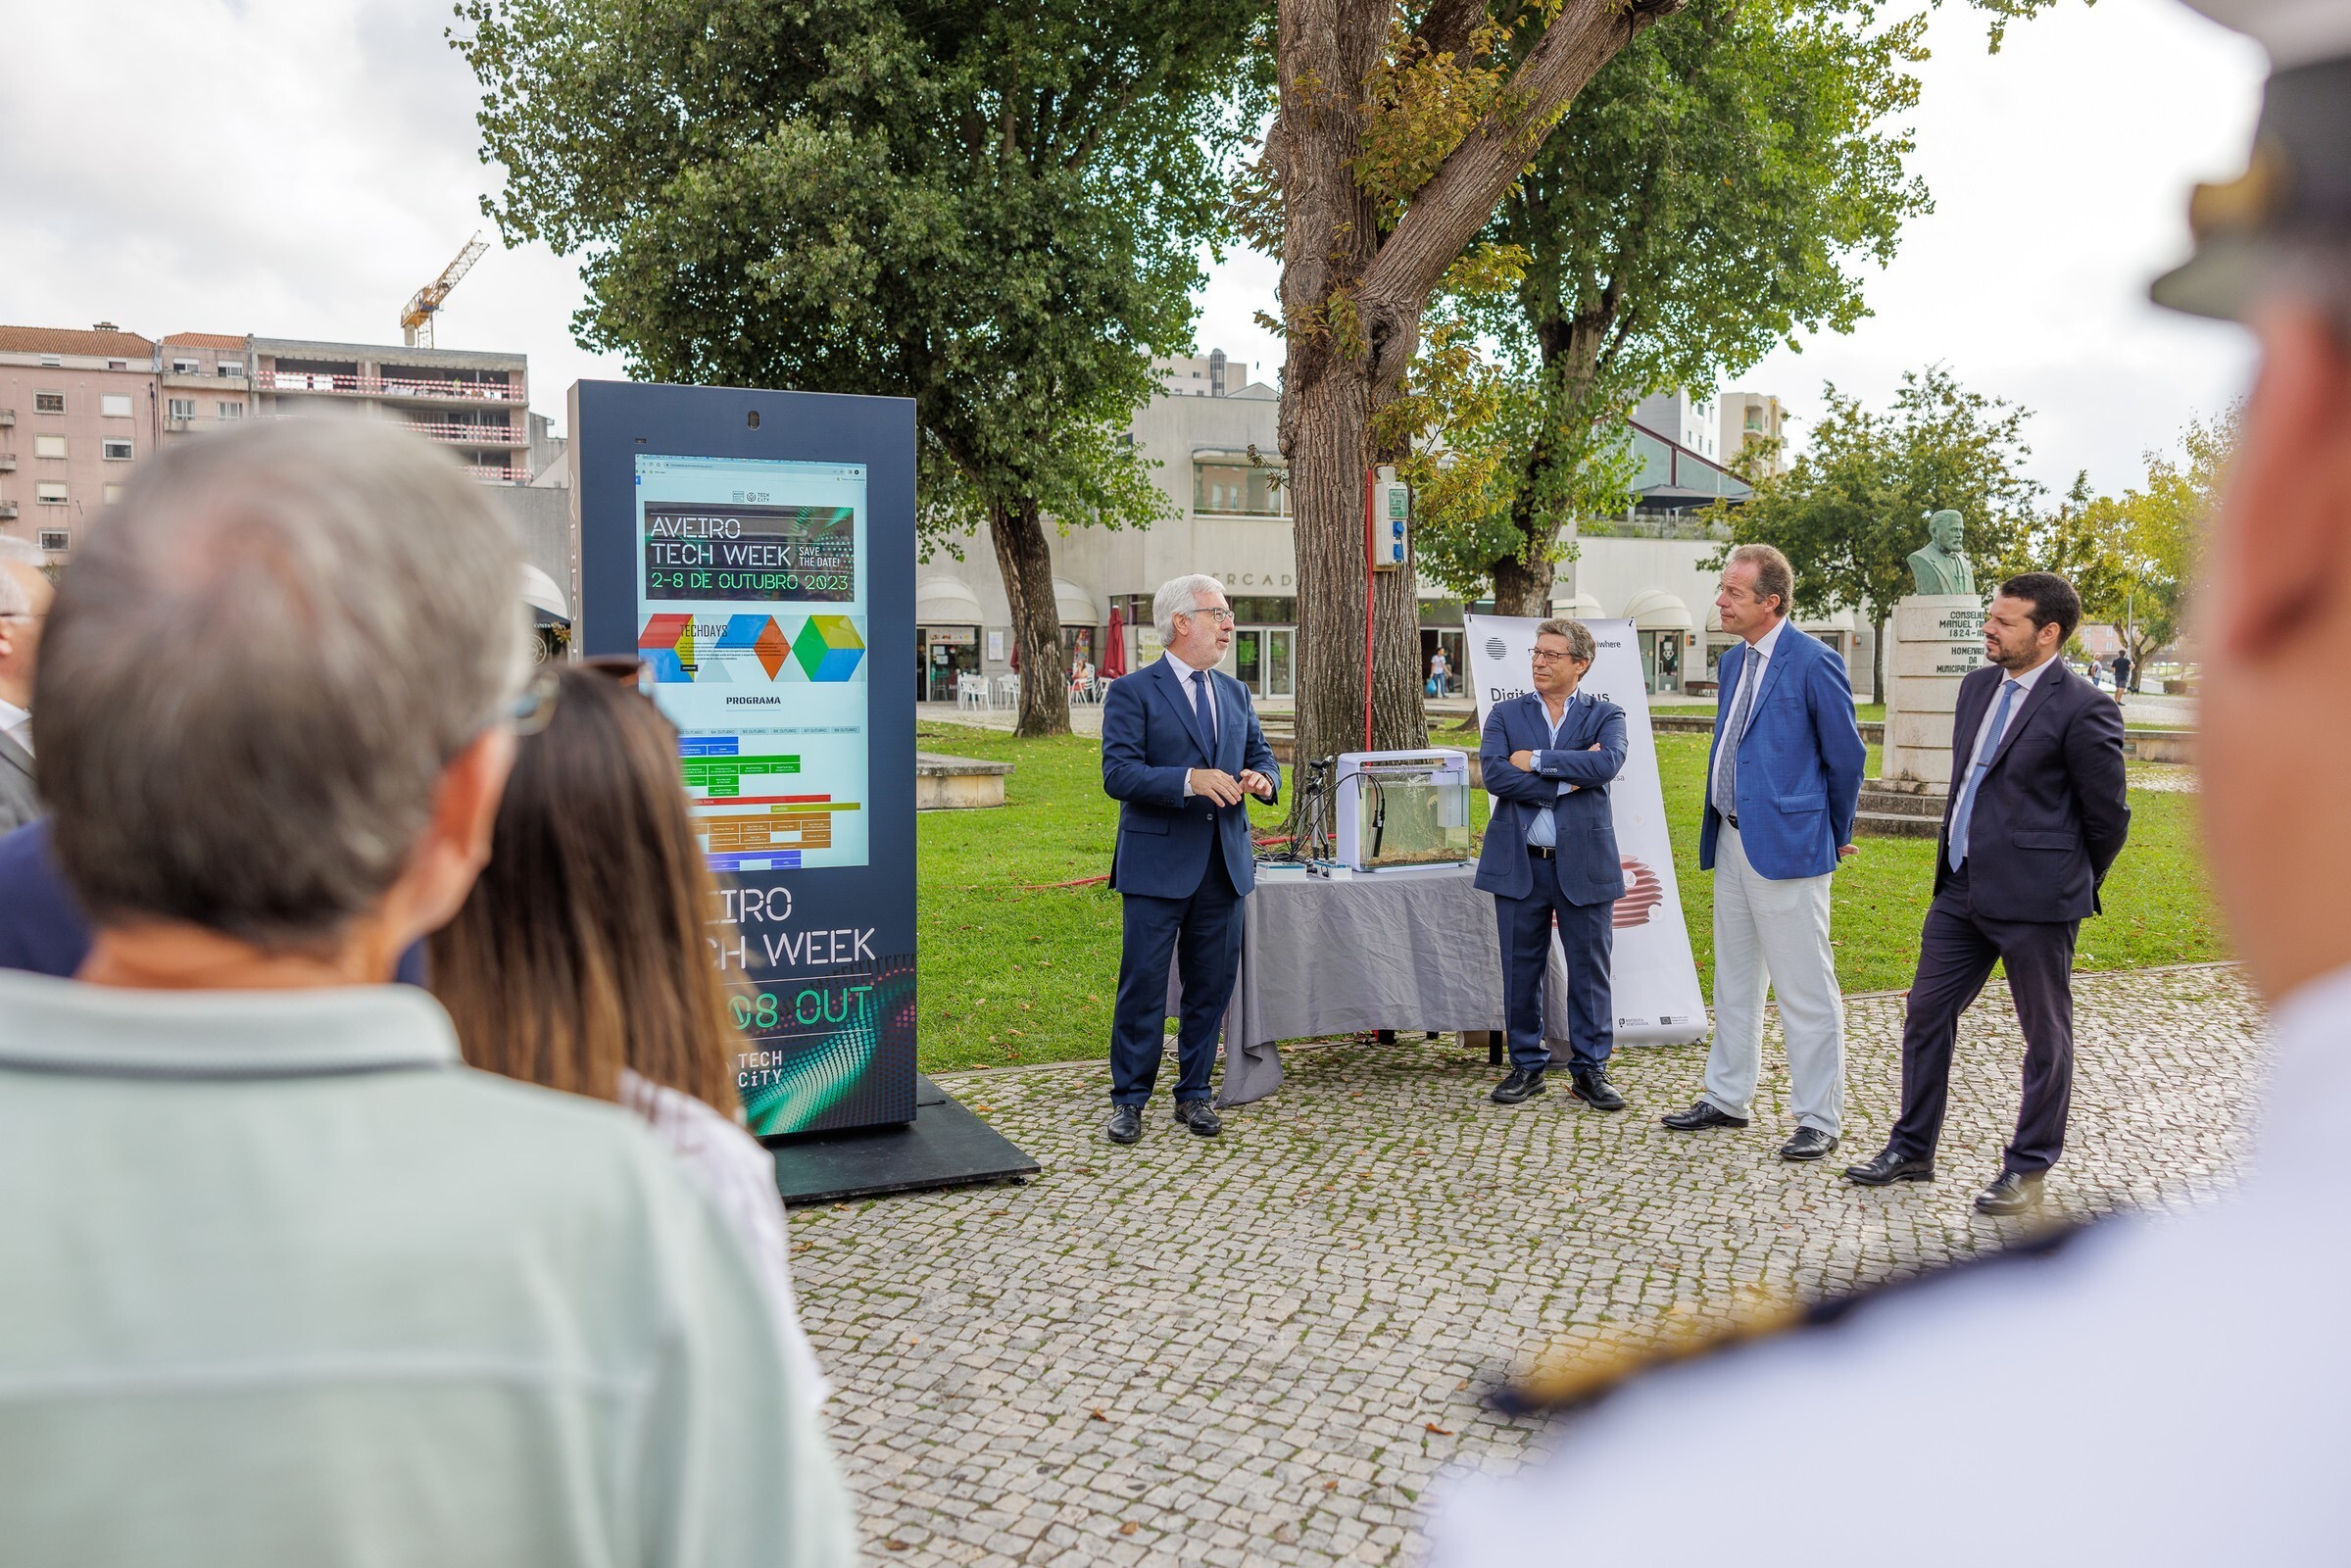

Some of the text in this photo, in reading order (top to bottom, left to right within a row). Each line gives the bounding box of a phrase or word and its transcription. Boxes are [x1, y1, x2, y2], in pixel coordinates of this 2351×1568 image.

[651, 516, 741, 539] AVEIRO
[651, 543, 791, 566] TECH WEEK
[799, 546, 819, 557] SAVE
[799, 558, 840, 567] THE DATE!
[651, 572, 849, 590] 2-8 DE OUTUBRO 2023
[680, 625, 728, 637] TECHDAYS
[1596, 640, 1621, 649] iwhere
[726, 697, 781, 706] PROGRAMA
[762, 927, 876, 966] WEEK
[796, 985, 872, 1025] OUT
[738, 1051, 782, 1068] TECH
